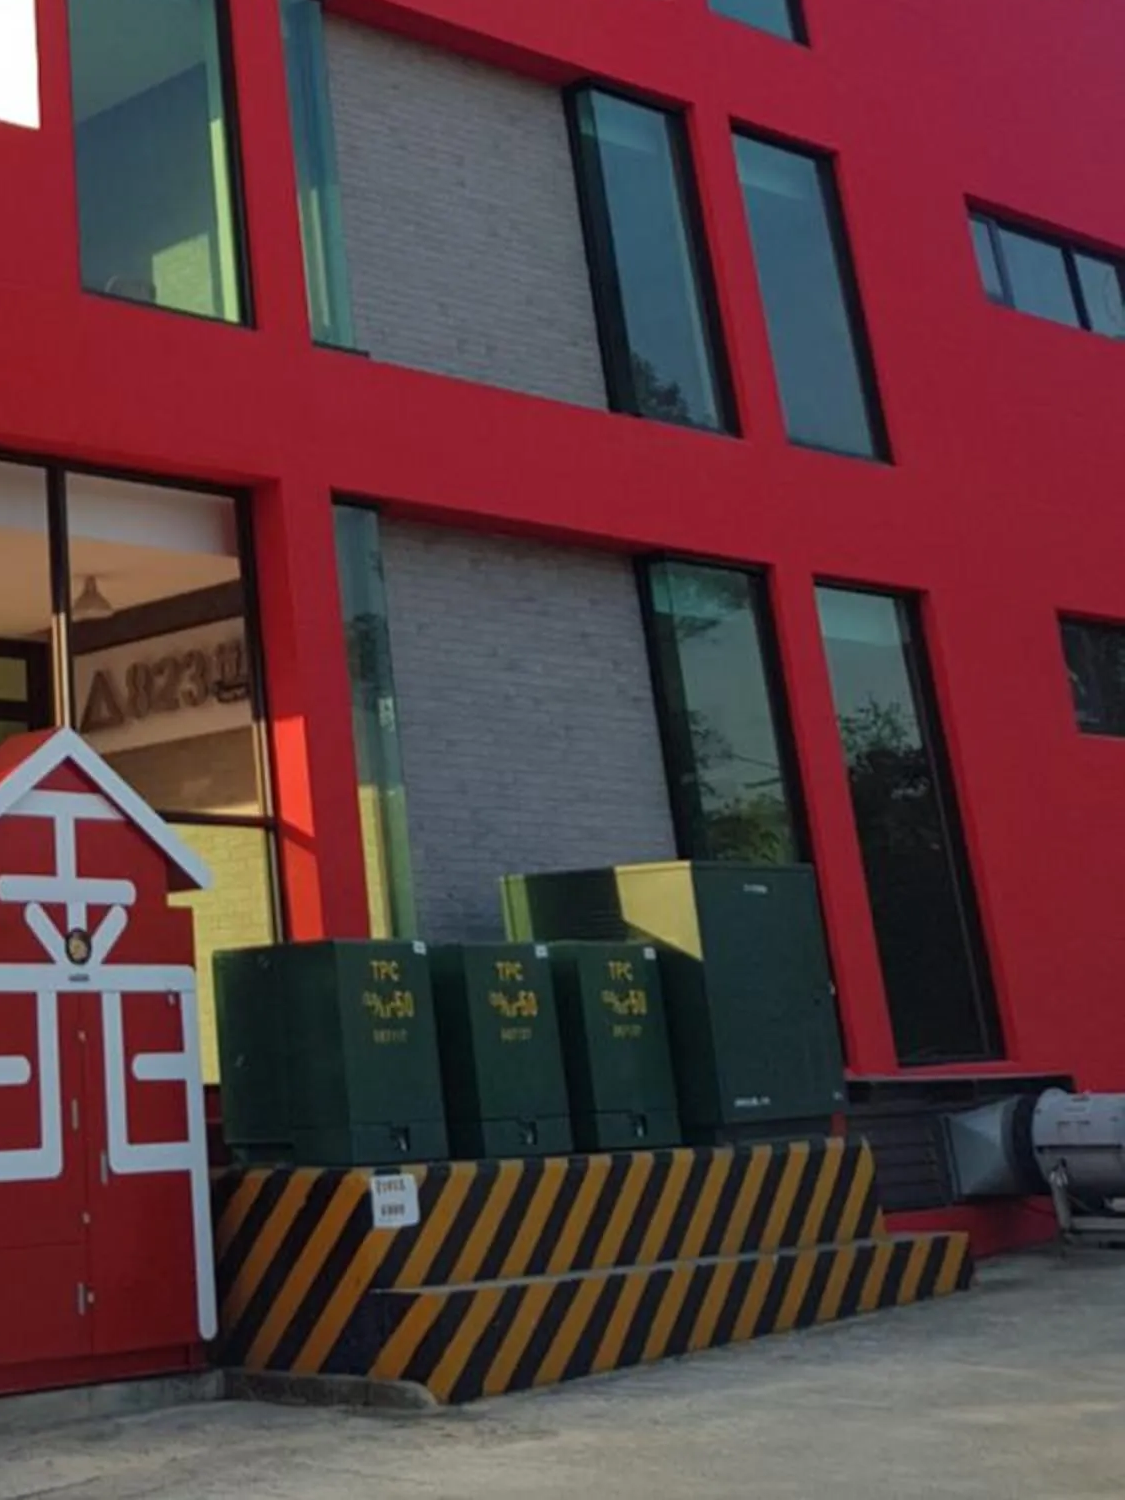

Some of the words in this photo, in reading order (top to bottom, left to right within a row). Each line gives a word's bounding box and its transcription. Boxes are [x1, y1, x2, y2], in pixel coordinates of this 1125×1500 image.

[370, 960, 400, 981] TPC
[495, 961, 524, 981] TPC
[608, 961, 635, 981] TPC
